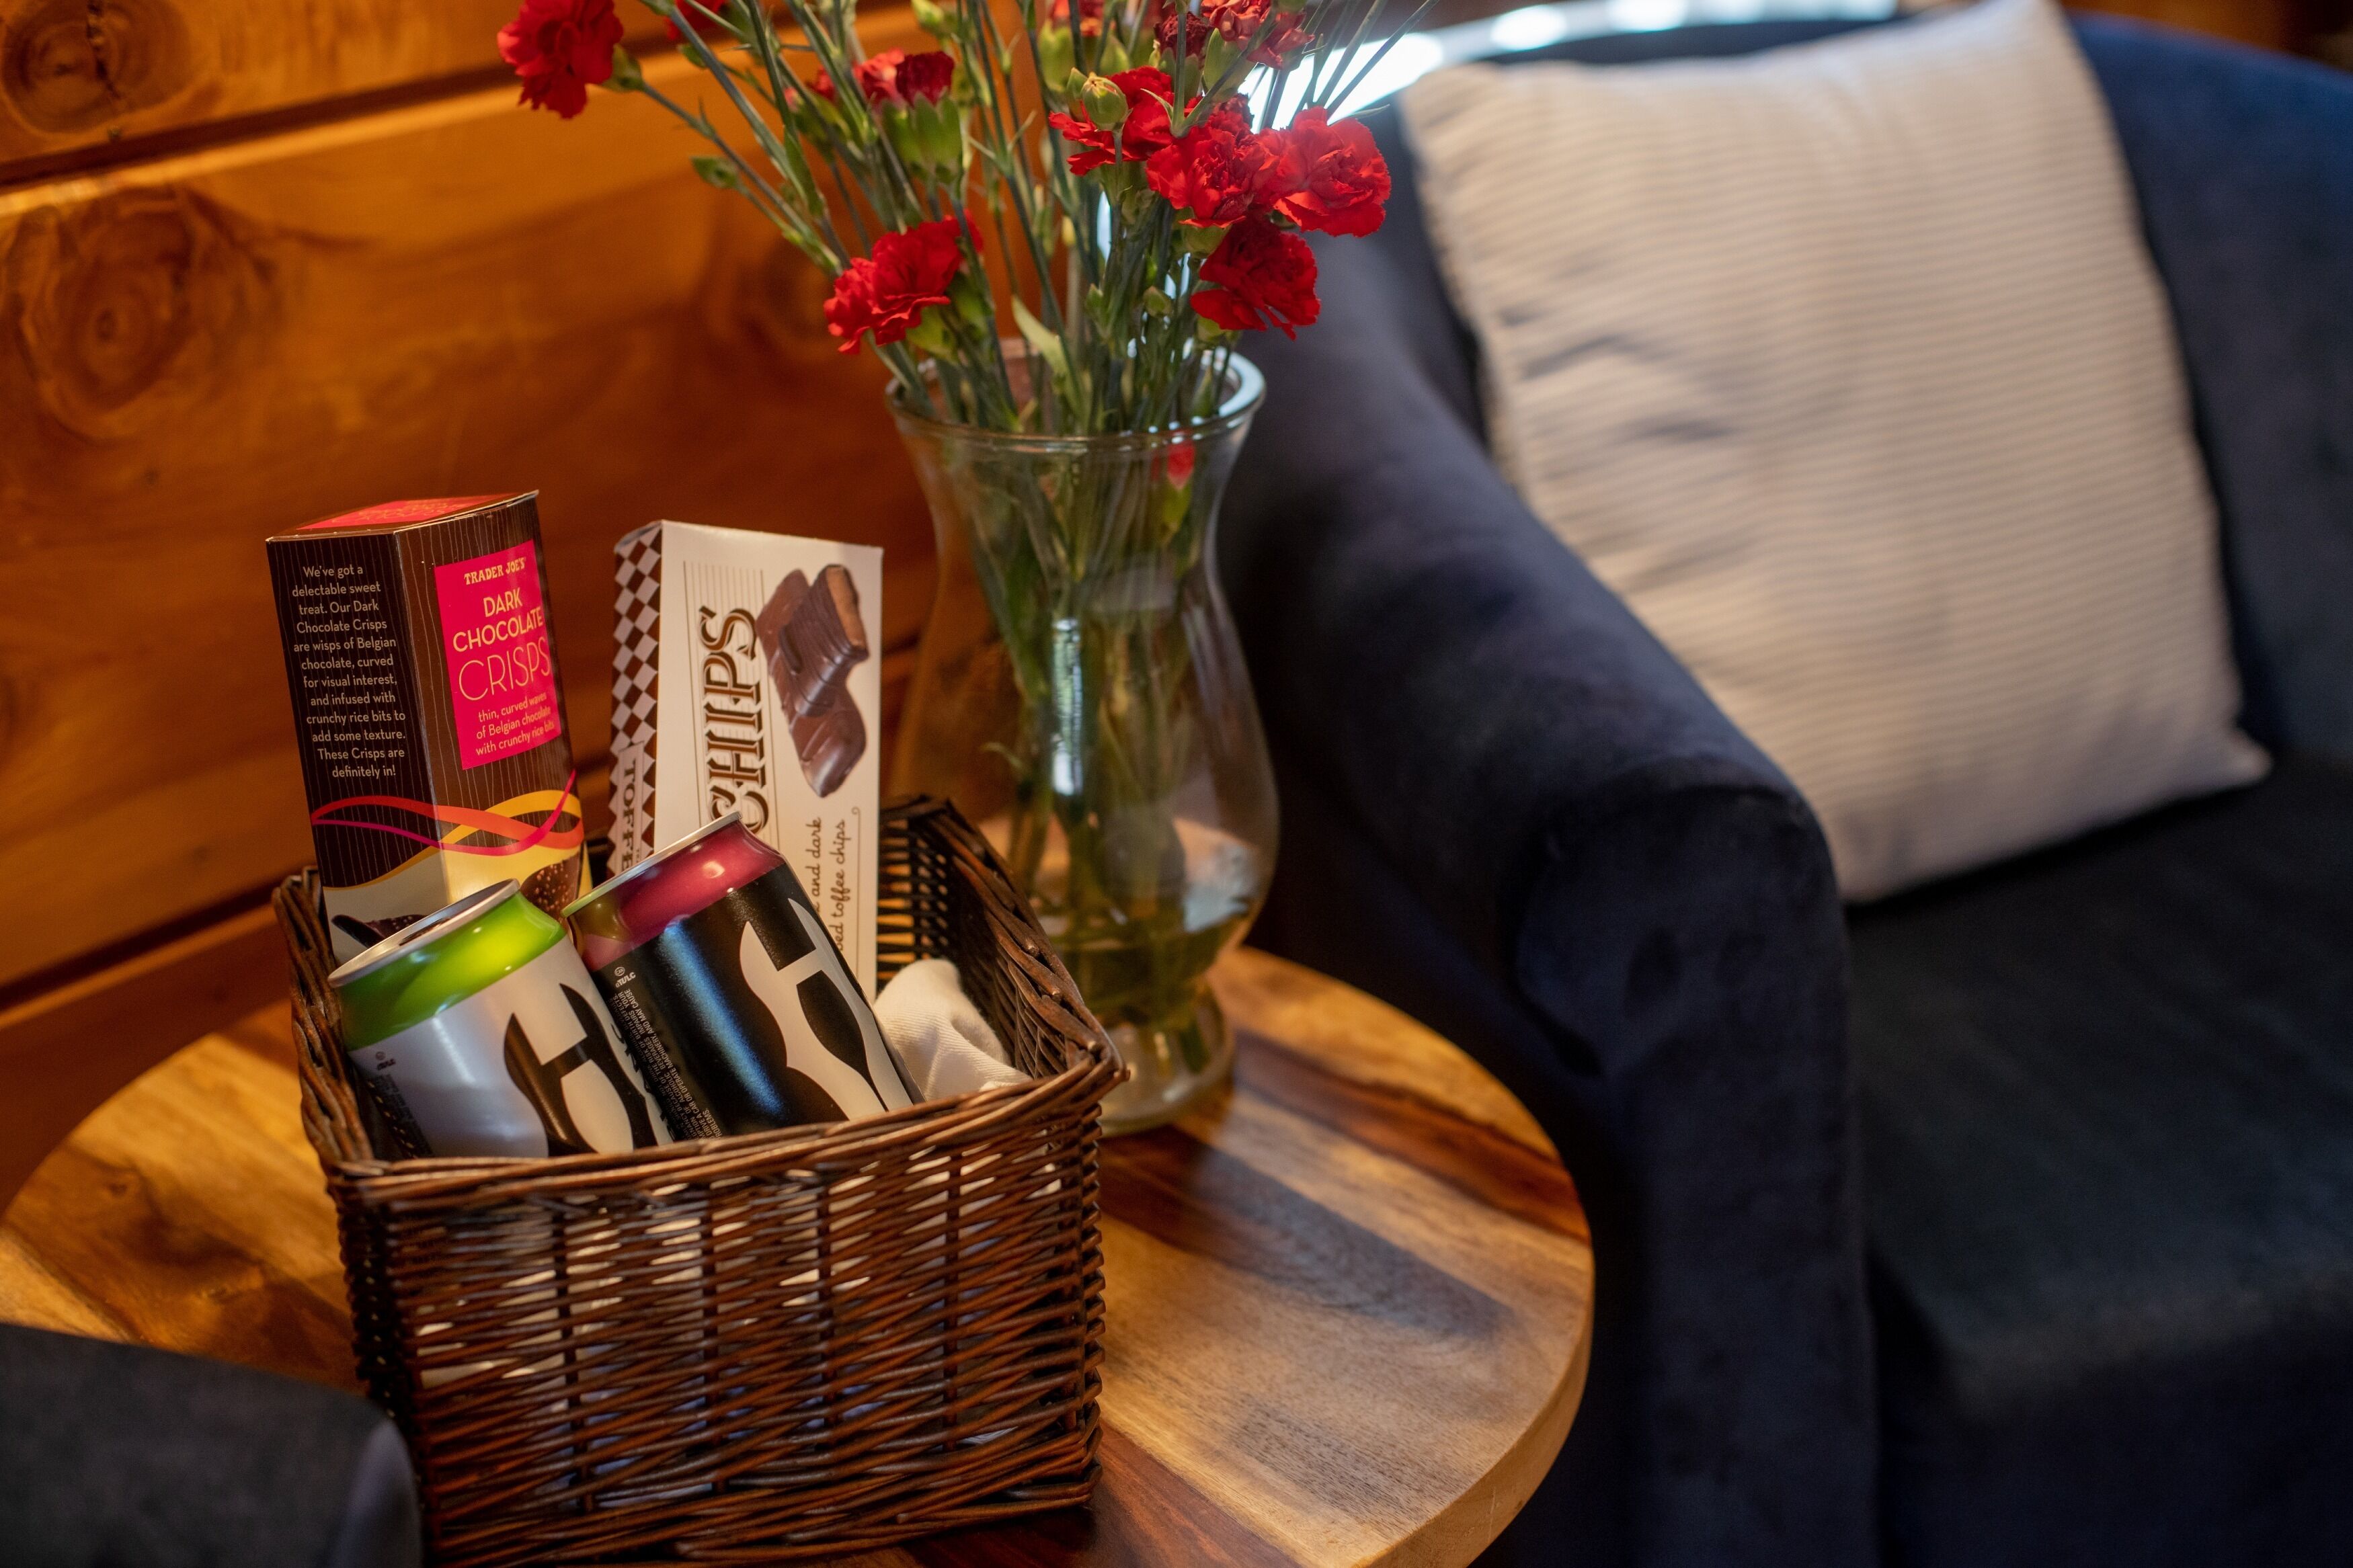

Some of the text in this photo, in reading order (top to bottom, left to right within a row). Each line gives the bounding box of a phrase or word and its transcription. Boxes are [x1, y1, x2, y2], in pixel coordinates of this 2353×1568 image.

[303, 565, 335, 578] We've
[337, 565, 355, 579] got
[464, 557, 526, 585] TRADER JOE'S
[292, 581, 381, 597] delectable sweet
[299, 599, 379, 615] treat. Our Dark
[483, 587, 522, 617] DARK
[297, 619, 387, 633] Chocolate Crisps
[453, 607, 543, 652] CHOCOLATE
[294, 636, 396, 653] are wisps of Belgian
[302, 653, 393, 670] chocolate, curved
[458, 636, 551, 700] CRISPS
[303, 673, 397, 688] for visual interest,
[311, 691, 395, 706] and infused with
[479, 692, 547, 723] thin, curved waves
[307, 710, 405, 726] crunchy rice bits to
[477, 706, 551, 739] of Belgian chocolate
[699, 605, 768, 834] CHIPS
[312, 729, 405, 742] add some texture.
[476, 720, 554, 755] with crunchy rice bits
[317, 747, 405, 761] These Crisps are
[332, 765, 396, 780] definitely in!
[805, 817, 822, 859] dark
[829, 819, 852, 865] chips
[805, 863, 821, 897] and
[830, 869, 851, 919] toffee
[616, 991, 630, 1007] YOUR
[623, 988, 639, 1008] CAUSE
[611, 993, 630, 1021] DEFECTS.
[634, 1007, 647, 1022] MAY
[627, 1009, 645, 1034] IMPAIRS
[641, 1020, 654, 1034] AND
[627, 1021, 641, 1040] BIRTH
[637, 1039, 646, 1048] OF
[649, 1033, 674, 1069] MACHINERY,
[642, 1036, 666, 1070] BEVERAGES
[643, 1048, 654, 1063] RISK
[651, 1063, 662, 1075] THE
[657, 1075, 666, 1084] OF
[663, 1071, 685, 1103] ALCOHOLIC
[668, 1067, 688, 1094] OPERATE
[663, 1084, 682, 1112] BECAUSE
[682, 1092, 692, 1102] OR
[682, 1105, 691, 1114] OF
[686, 1102, 699, 1114] CAR
[697, 1118, 713, 1136] DRIVE
